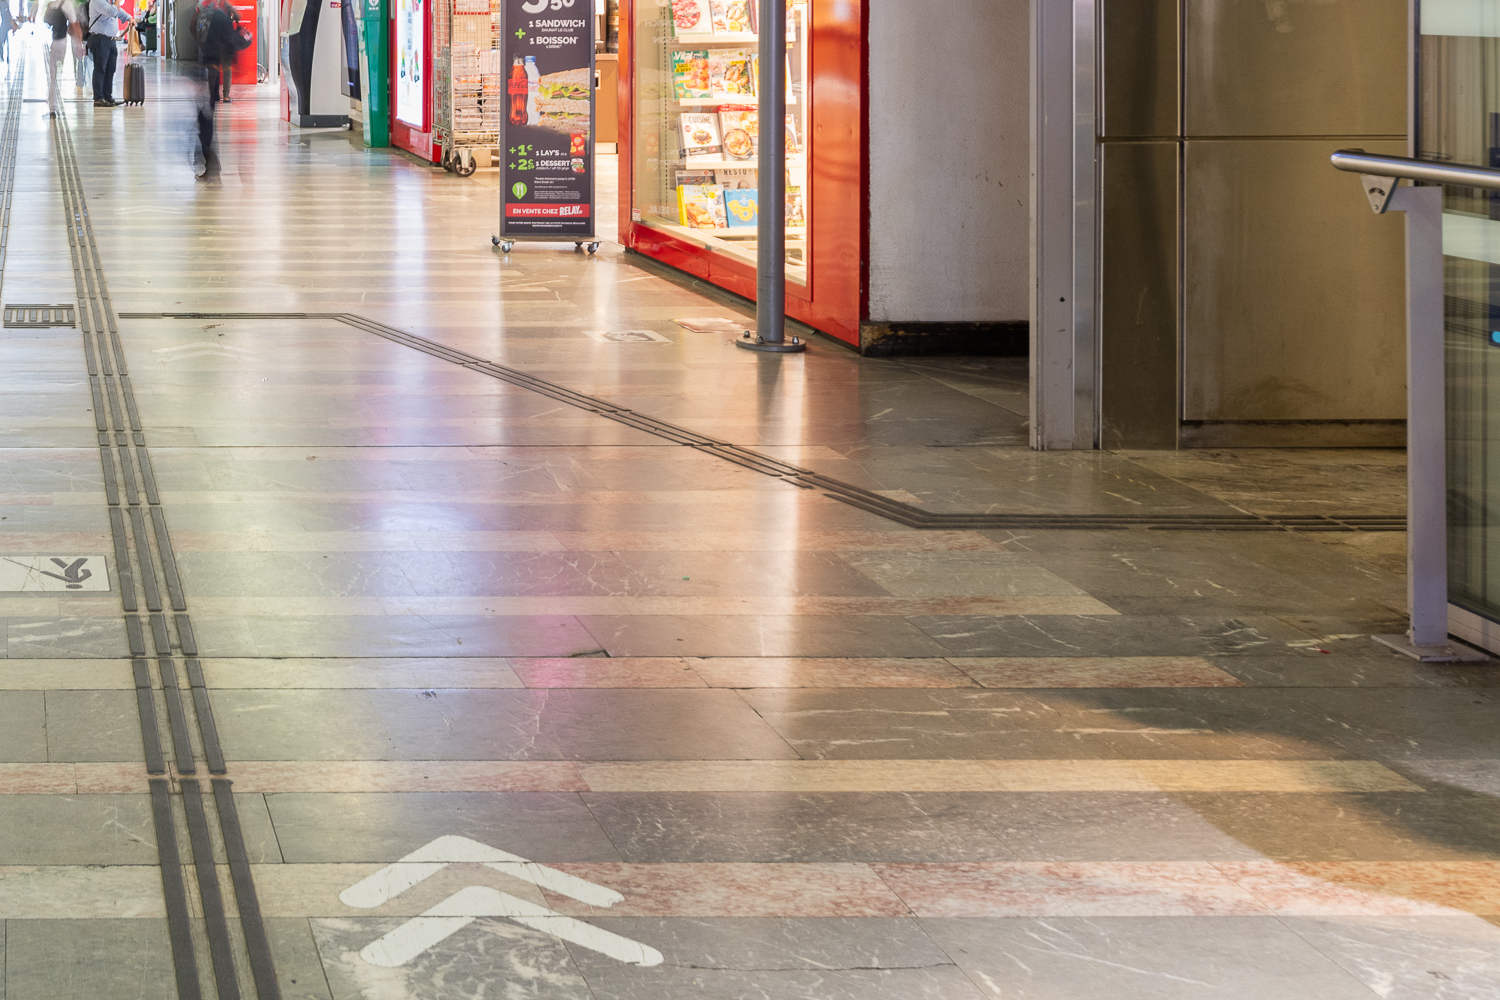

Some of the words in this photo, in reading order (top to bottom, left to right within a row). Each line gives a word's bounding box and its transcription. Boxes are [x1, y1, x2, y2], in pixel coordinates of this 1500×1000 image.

[535, 19, 586, 27] SANDWICH
[674, 51, 694, 60] Vital
[688, 115, 712, 124] CUISINE
[559, 205, 582, 216] RELAY
